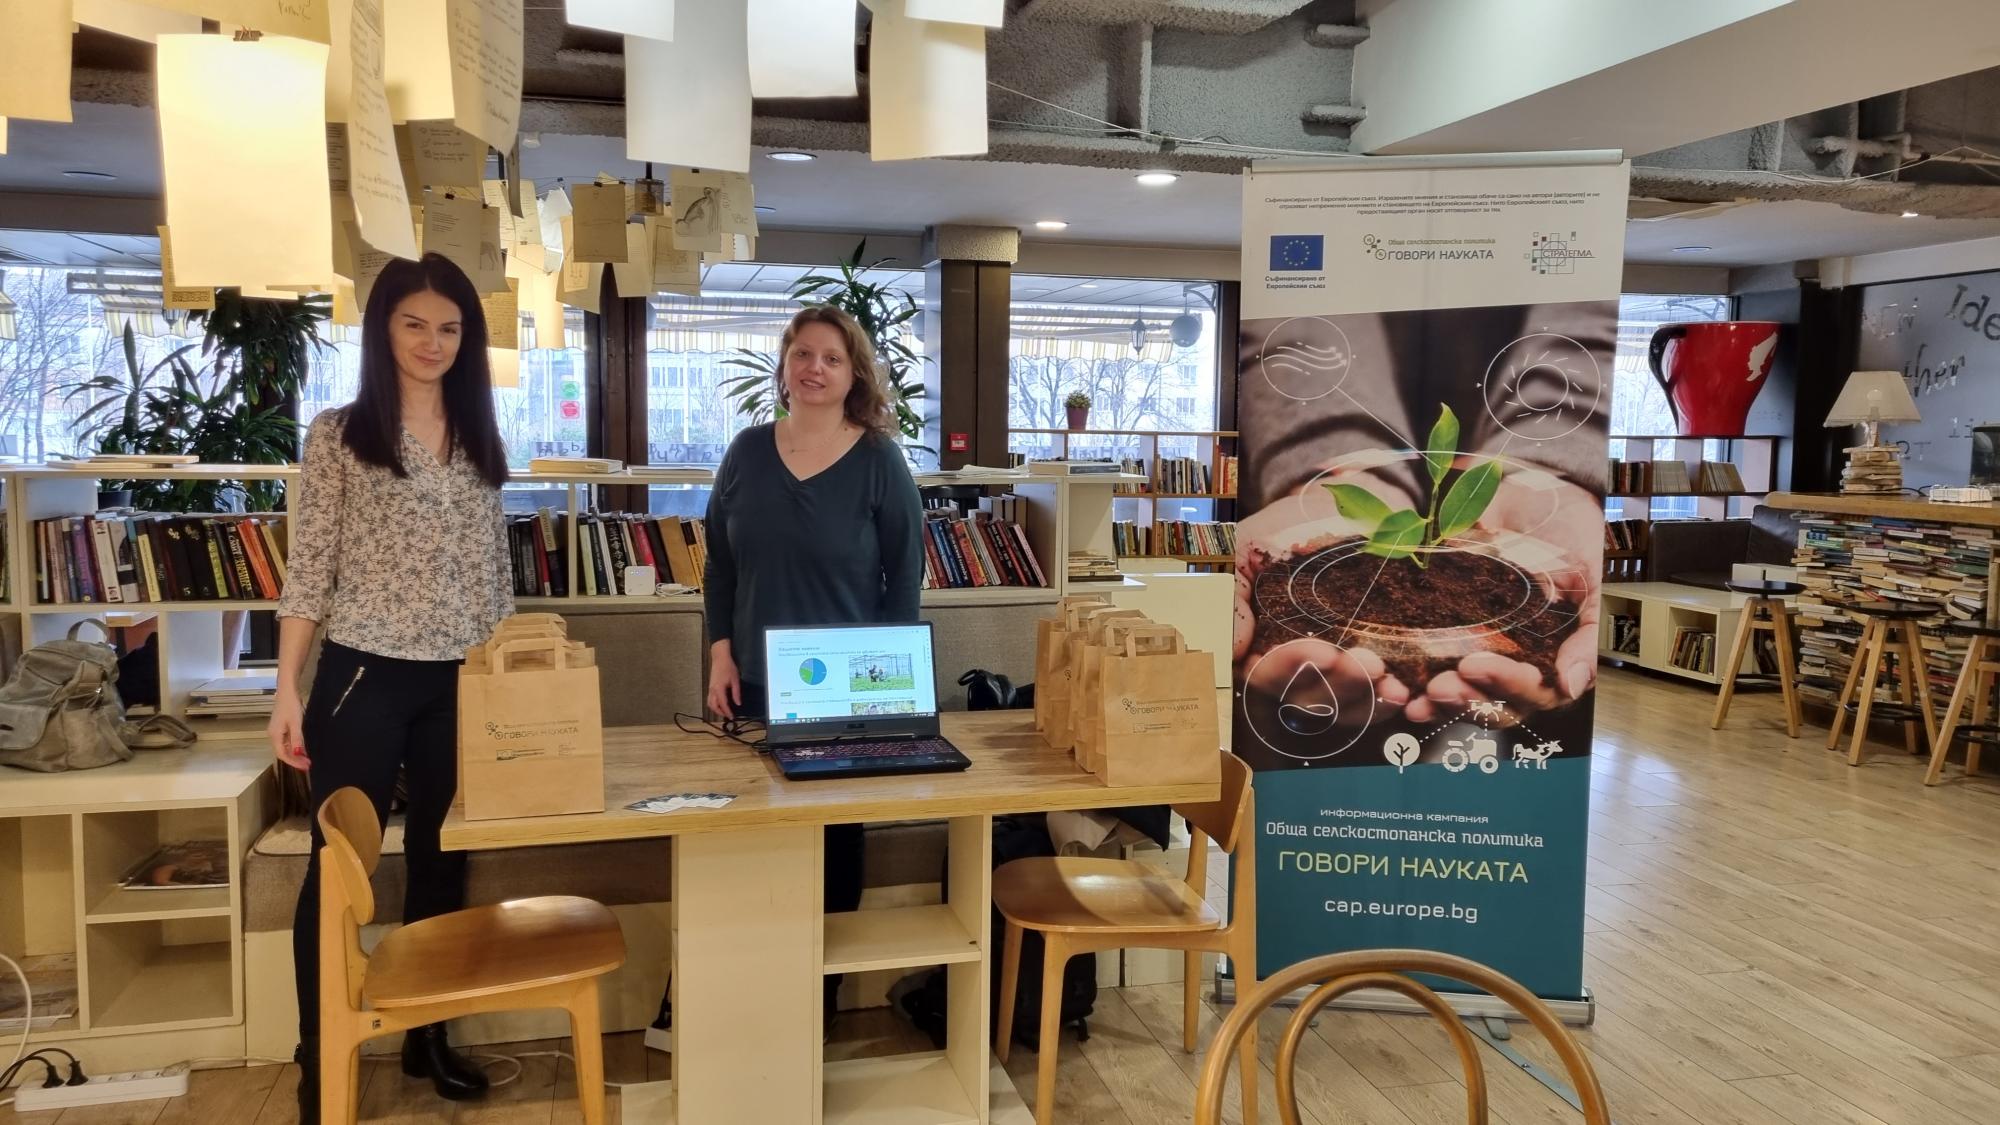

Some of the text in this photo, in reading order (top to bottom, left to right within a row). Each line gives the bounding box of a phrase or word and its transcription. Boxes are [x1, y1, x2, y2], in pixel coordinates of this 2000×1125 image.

[1387, 249, 1495, 260] ГОВОРИ НАУКАТА
[1320, 807, 1489, 824] информационна кампания
[1266, 822, 1544, 848] Обща селскостопанска политика
[1279, 851, 1528, 883] ГОВОРИ НАУКАТА
[1324, 899, 1478, 923] cap.europe.bg
